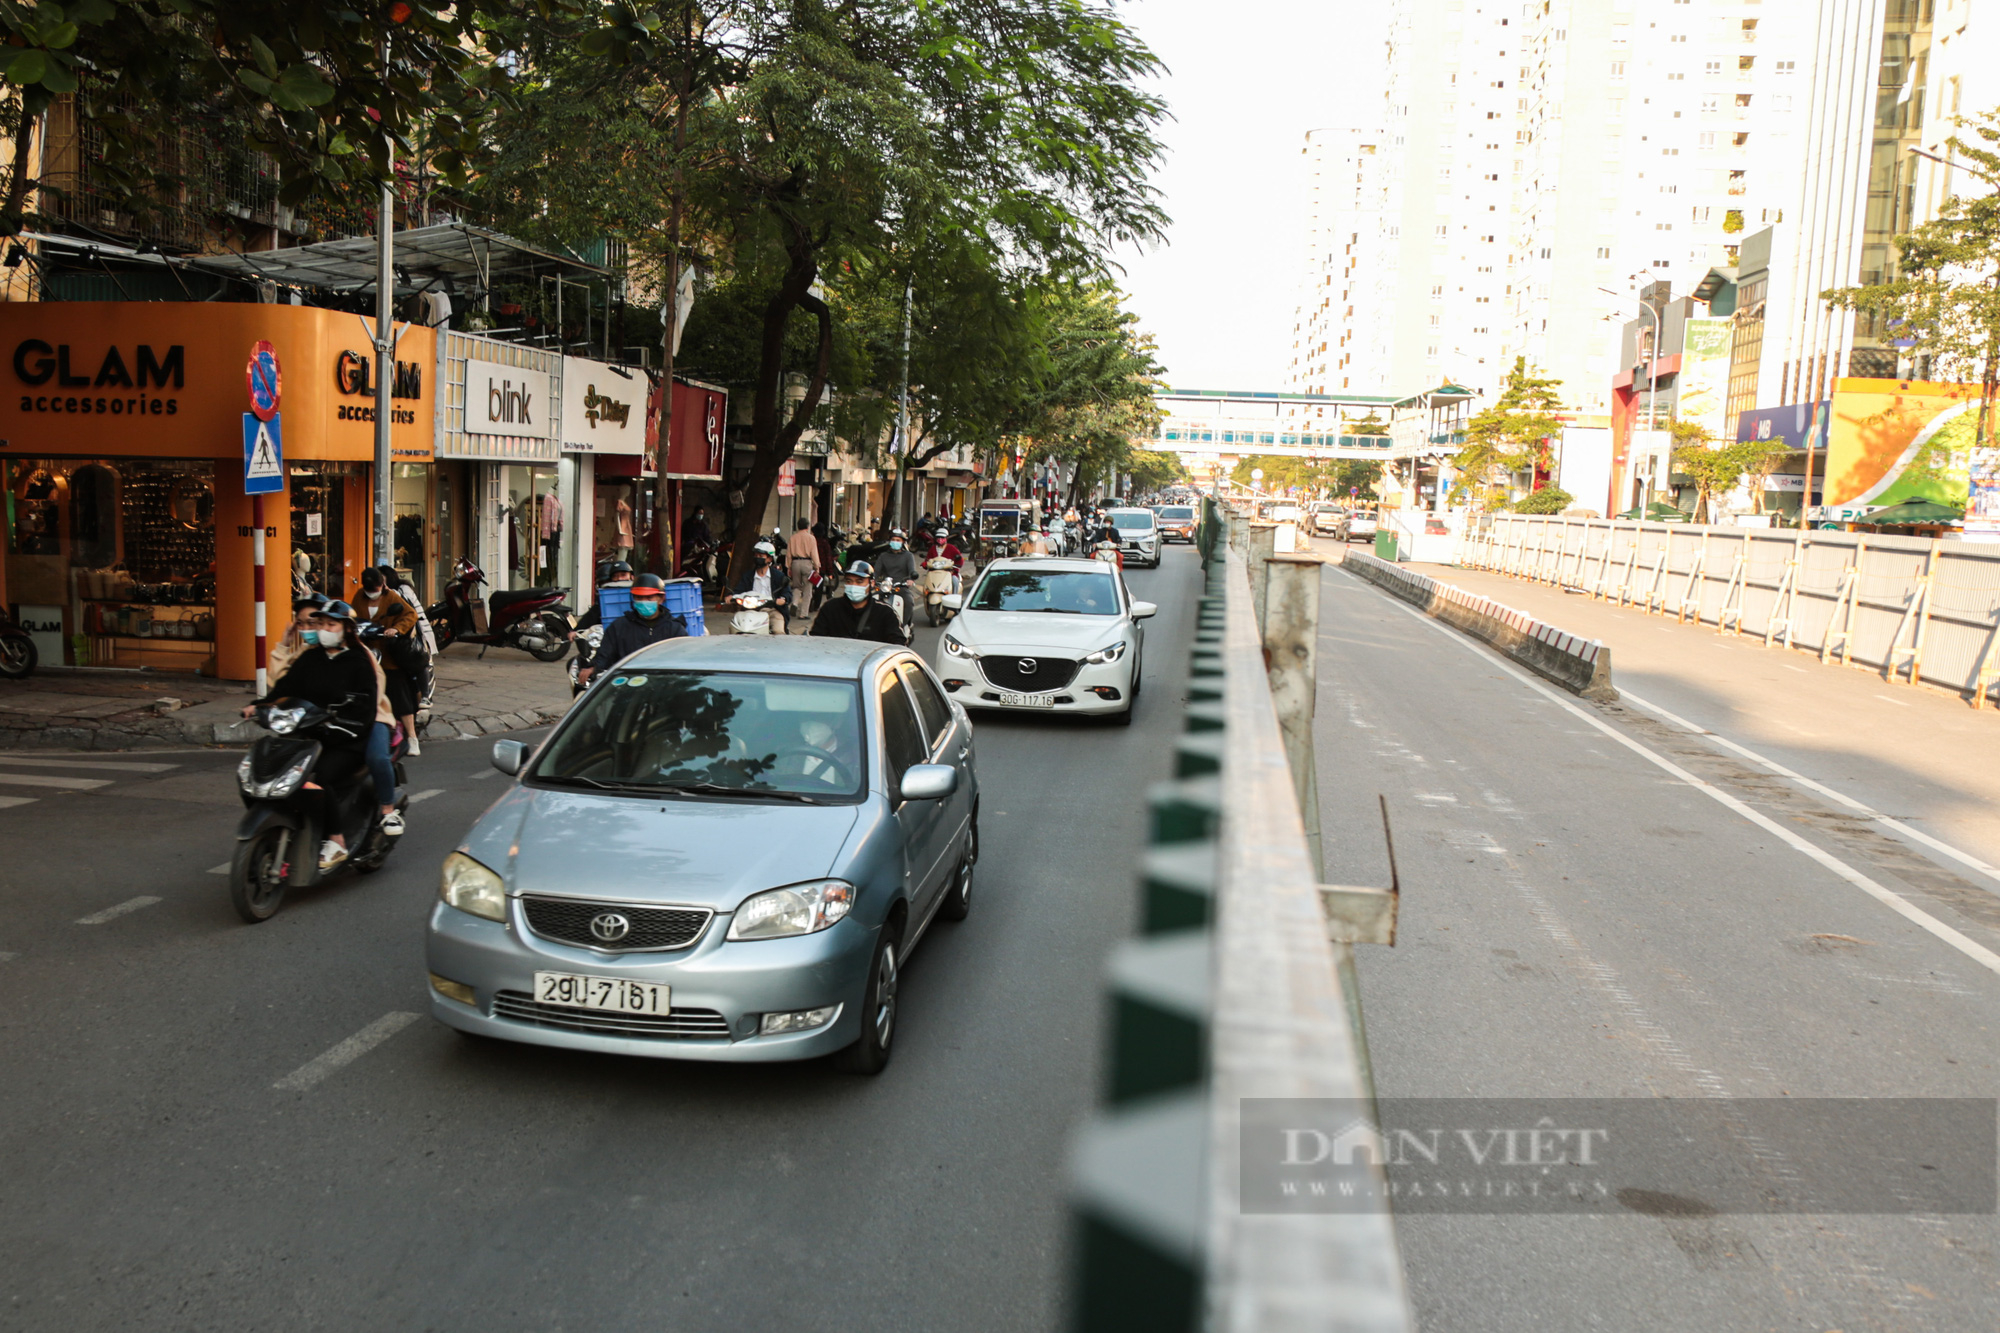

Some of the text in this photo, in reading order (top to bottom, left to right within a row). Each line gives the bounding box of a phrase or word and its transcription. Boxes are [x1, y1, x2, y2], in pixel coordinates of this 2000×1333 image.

[13, 339, 184, 388] GLAM
[20, 393, 178, 415] accessories
[489, 377, 532, 424] blink
[338, 405, 415, 424] accesries
[1757, 419, 1772, 439] MB
[266, 526, 277, 537] C1
[22, 619, 61, 632] GLAM
[1001, 694, 1052, 706] 30G-117.16
[543, 976, 658, 1012] 29U-7161
